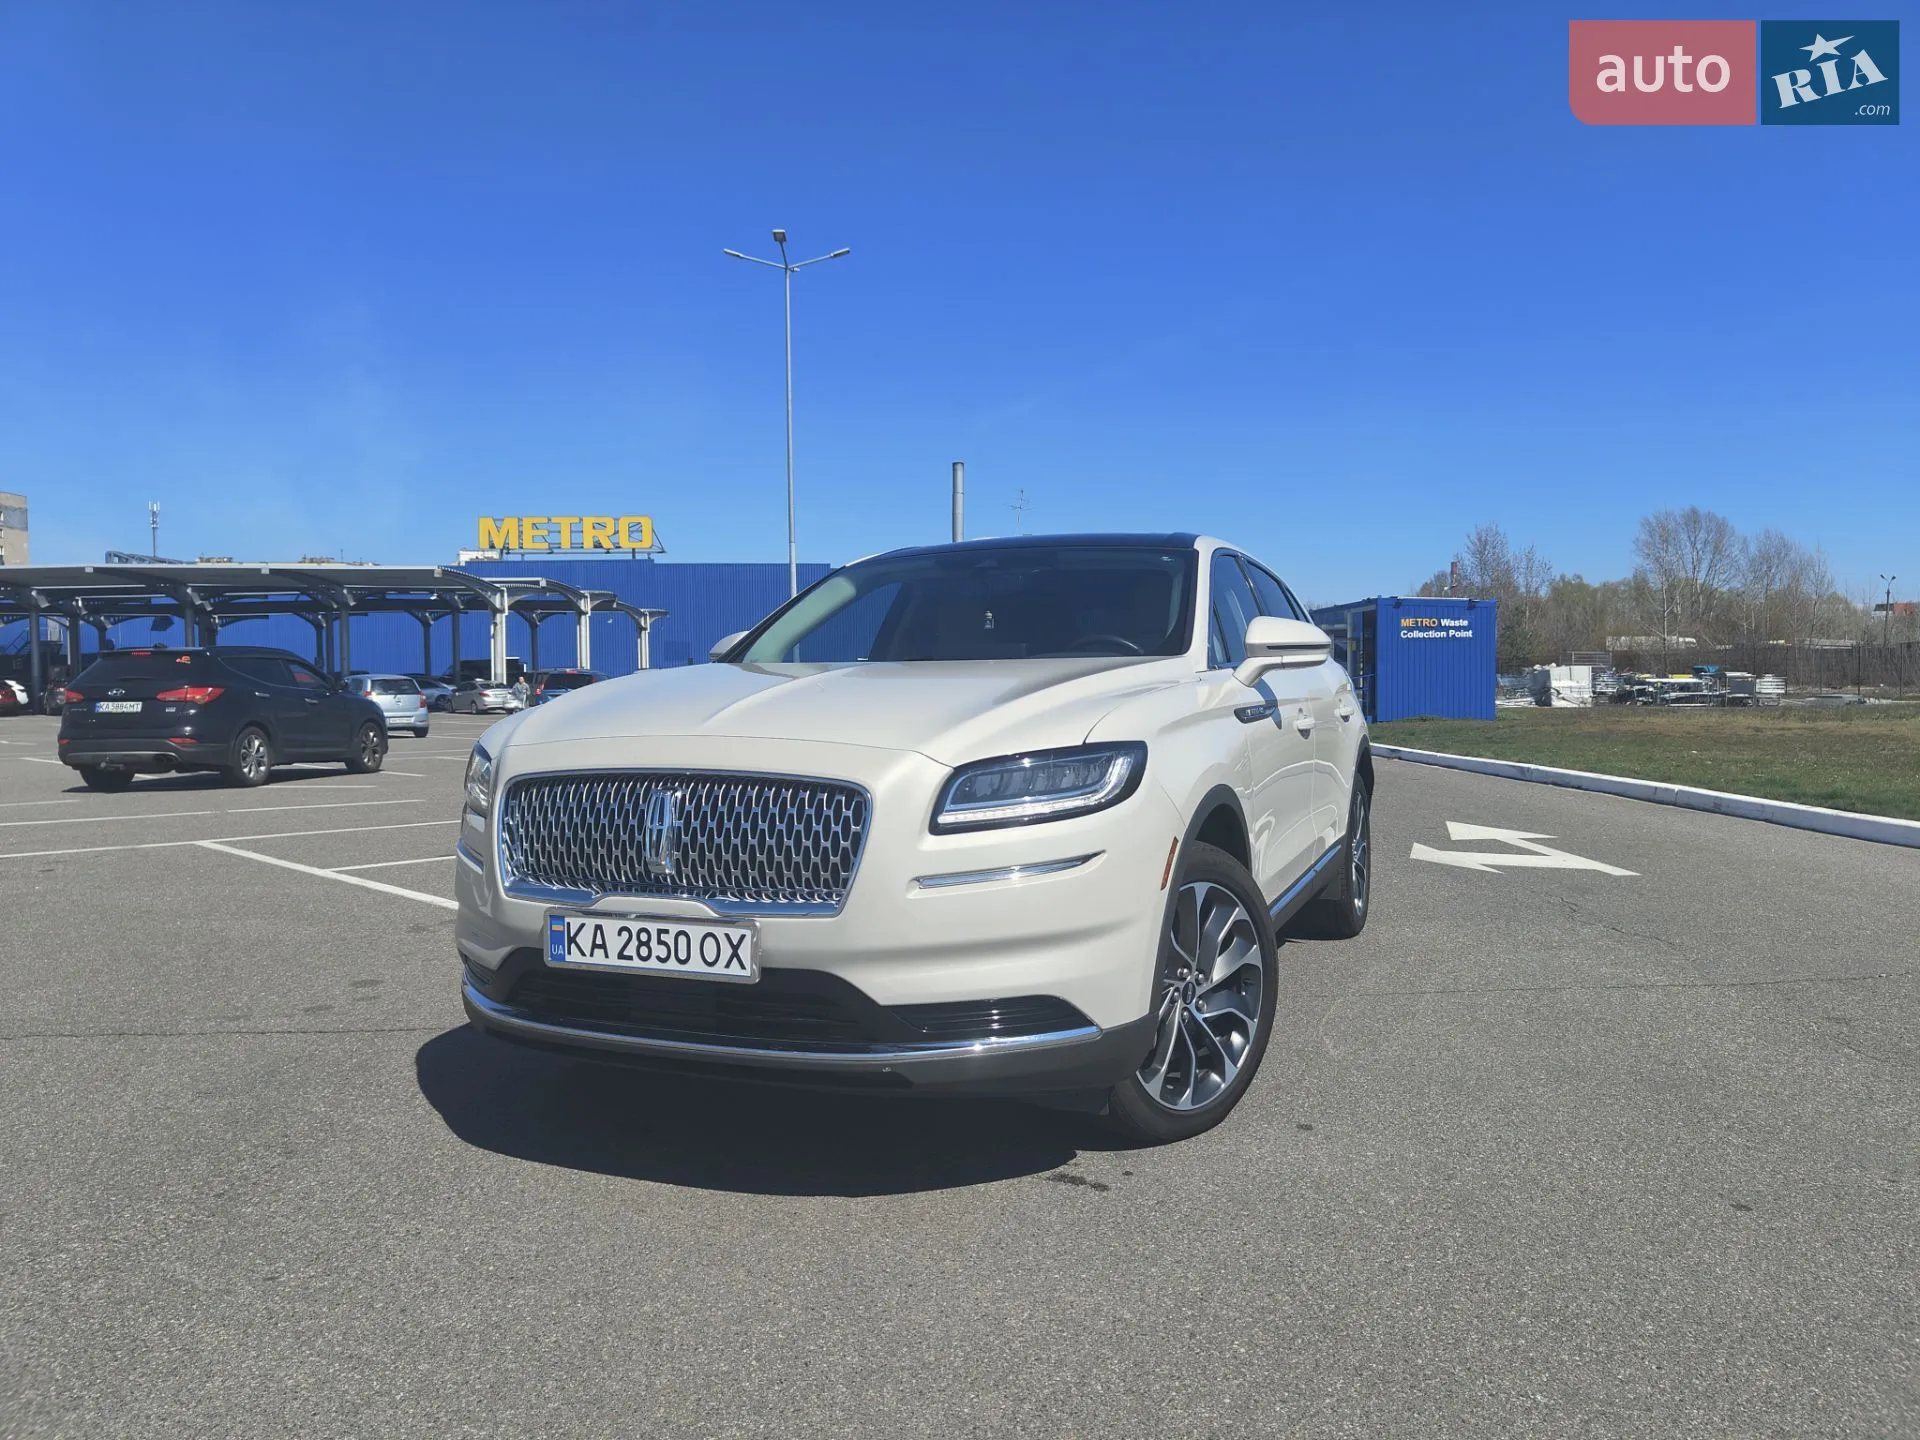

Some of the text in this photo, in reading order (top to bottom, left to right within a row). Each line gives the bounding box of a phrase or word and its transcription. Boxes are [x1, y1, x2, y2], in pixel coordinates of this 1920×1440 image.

[478, 515, 653, 549] METRO
[1400, 618, 1469, 627] METRO Waste
[1400, 629, 1473, 638] Collection Point
[551, 944, 564, 955] UA
[566, 921, 747, 970] KA 2850 OX
